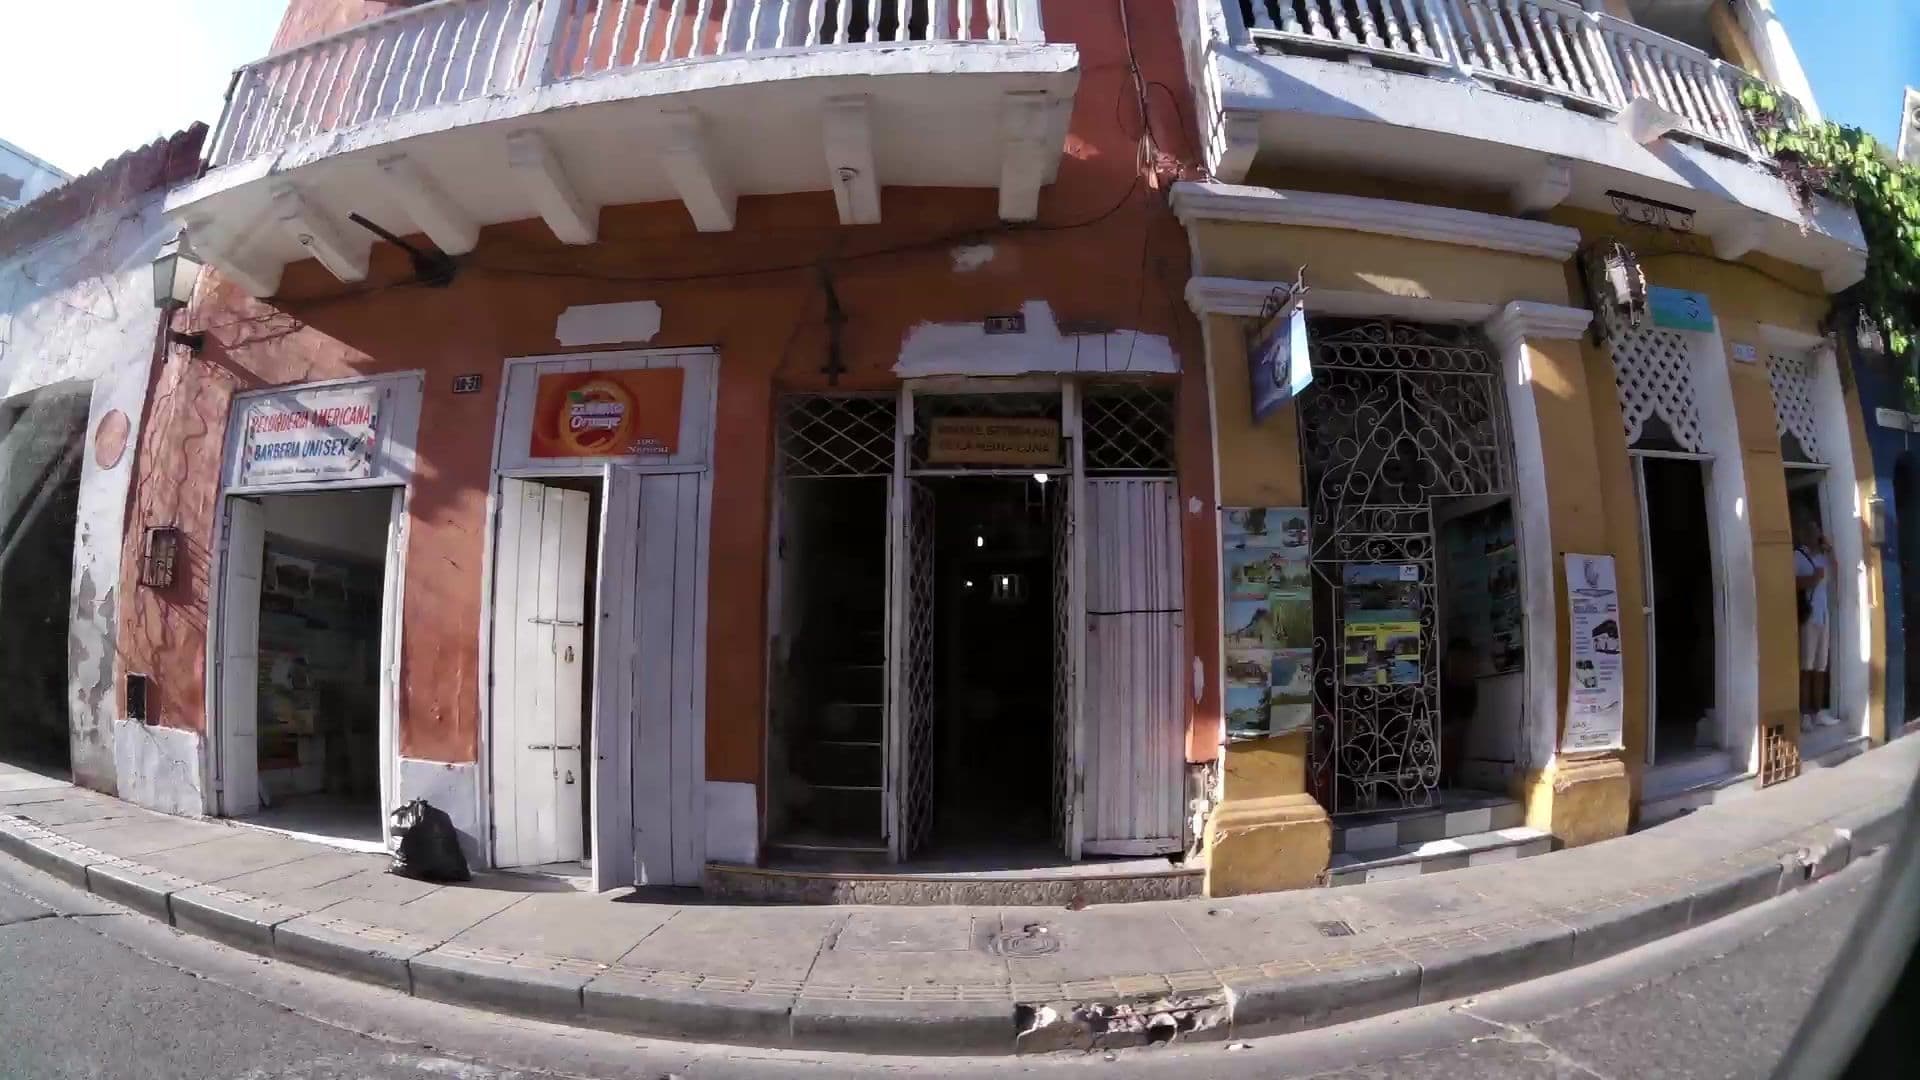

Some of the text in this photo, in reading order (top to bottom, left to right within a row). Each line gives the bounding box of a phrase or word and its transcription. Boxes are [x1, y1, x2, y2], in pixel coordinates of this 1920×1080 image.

[312, 404, 371, 428] AMERICANA
[254, 437, 349, 461] BARBERIA UNISEX
